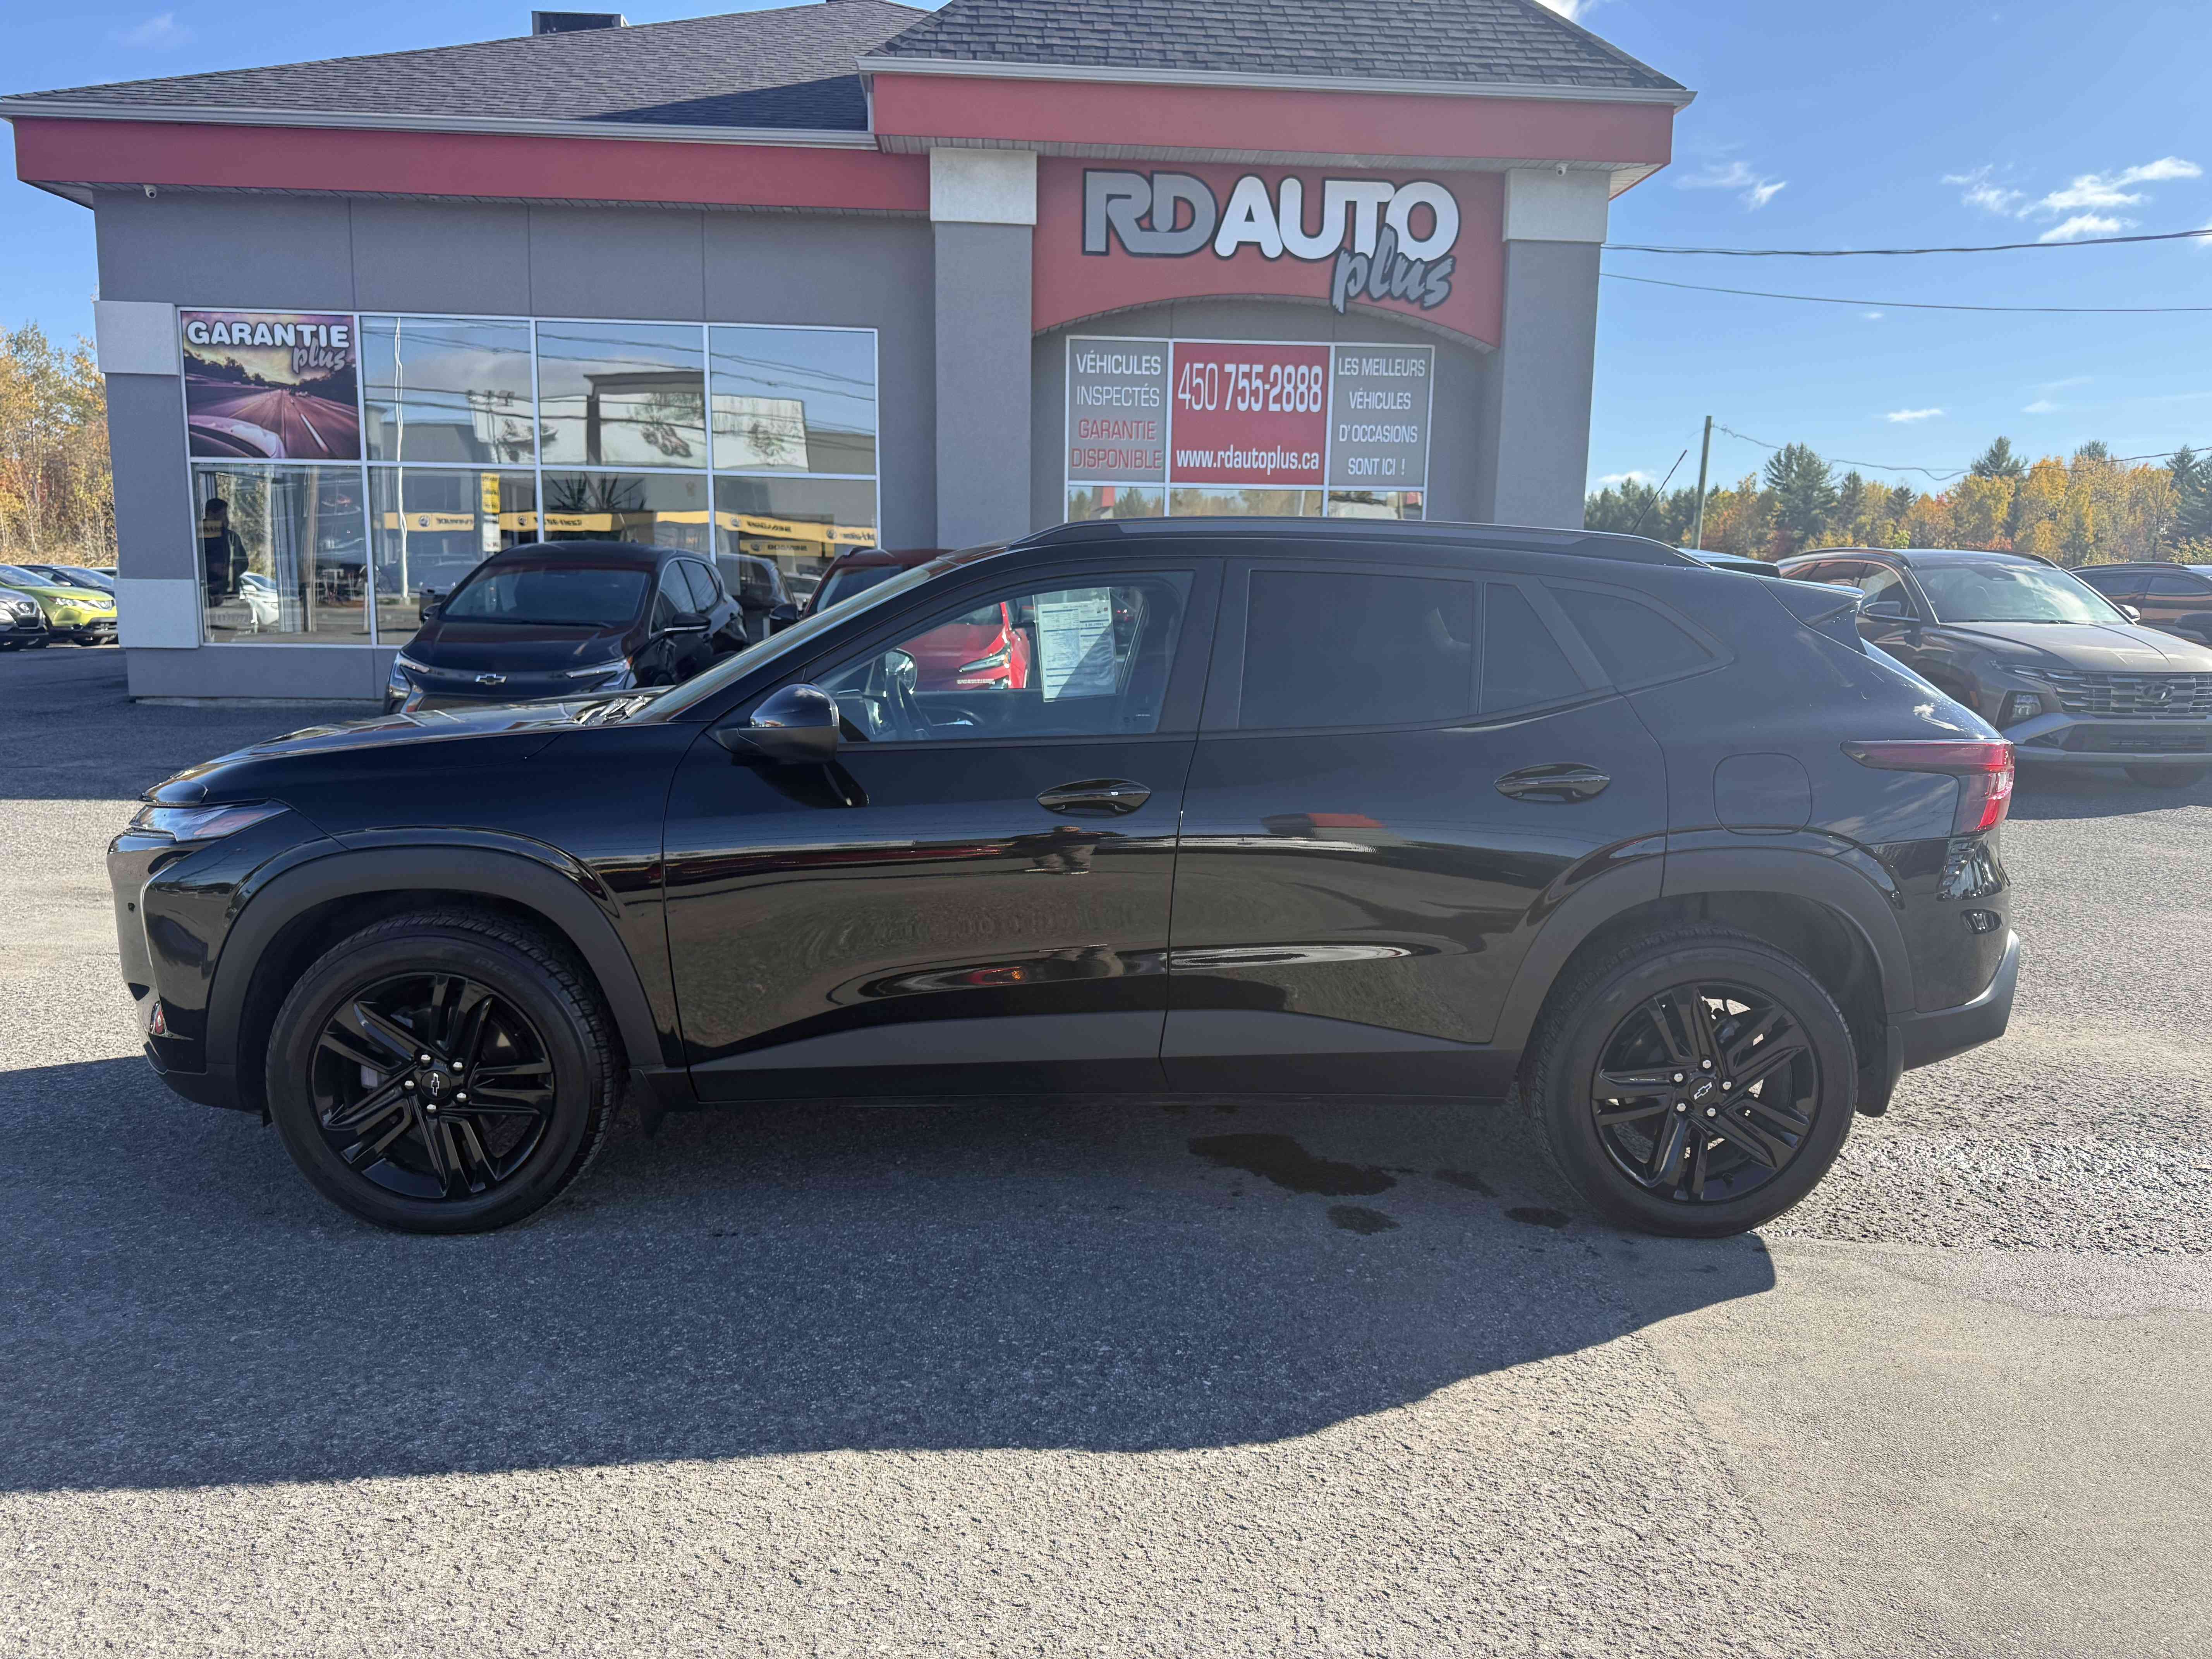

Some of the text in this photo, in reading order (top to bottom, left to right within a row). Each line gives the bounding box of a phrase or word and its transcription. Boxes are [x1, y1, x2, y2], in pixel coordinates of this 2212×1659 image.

[1331, 224, 1455, 314] plus
[187, 321, 349, 348] GARANTIE
[292, 337, 345, 374] plus
[1076, 350, 1161, 375] VÉHICULES
[1338, 358, 1425, 376] LES MEILLEURS
[1076, 383, 1160, 407] INSPECTÉS
[1178, 362, 1322, 413] 450 755-2888
[1350, 387, 1411, 410] VÉHICULES
[1079, 419, 1157, 441] GARANTIE
[1071, 448, 1163, 470] DISPONIBLE
[1176, 444, 1319, 476] www.rdautoplus.ca
[1348, 457, 1380, 475] SONT
[1382, 458, 1396, 476] ICI
